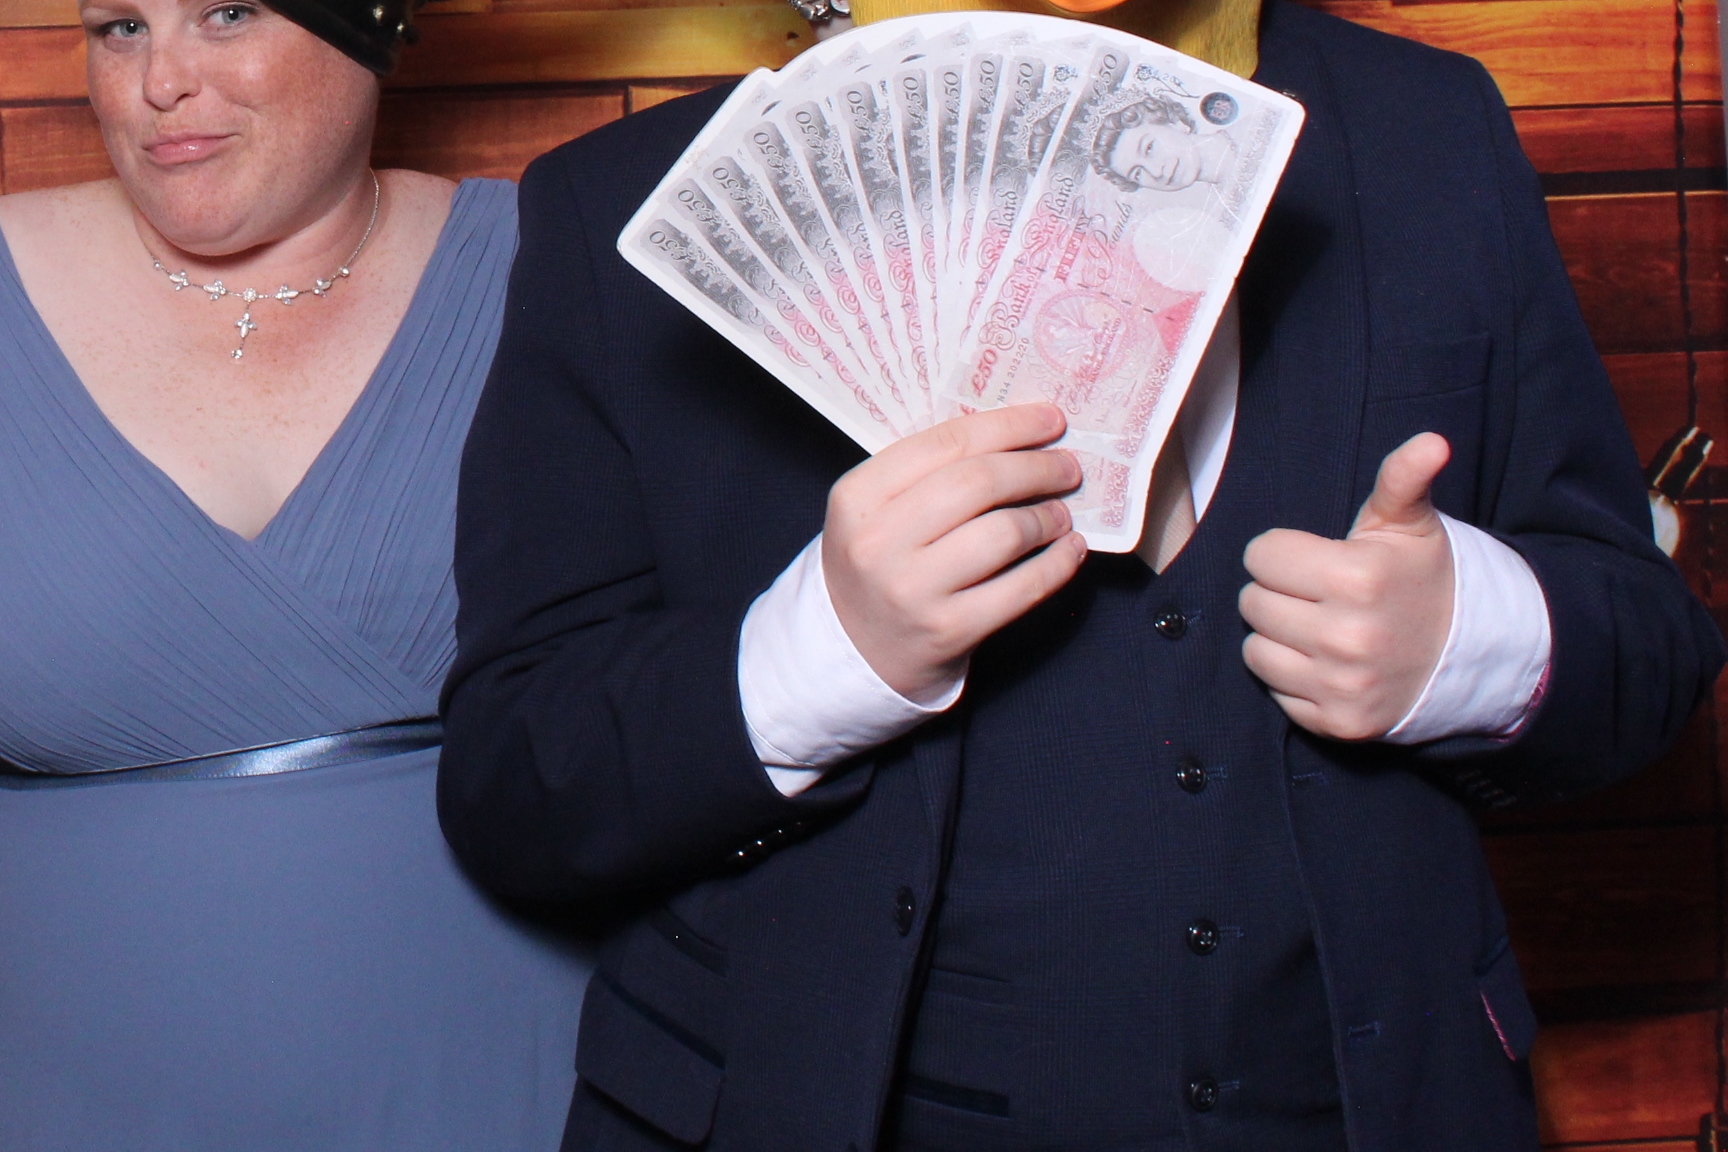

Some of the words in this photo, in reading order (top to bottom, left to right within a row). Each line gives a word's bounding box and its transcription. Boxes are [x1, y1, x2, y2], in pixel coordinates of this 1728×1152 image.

[943, 71, 961, 119] £50
[979, 60, 996, 112] £50
[1015, 62, 1034, 113] £50
[1092, 53, 1118, 99] £50
[847, 90, 873, 134] £50
[903, 76, 923, 125] £50
[753, 132, 789, 174] £50
[795, 110, 826, 152] £50
[677, 189, 719, 226] £50
[712, 167, 753, 204] £50
[649, 230, 693, 262] £50
[1021, 172, 1075, 272] England
[1054, 208, 1093, 284] FIFTY
[1081, 199, 1133, 288] Pounds
[1025, 266, 1038, 284] of
[978, 275, 1031, 351] Bank
[971, 348, 998, 398] £50
[996, 381, 1012, 403] N34
[1006, 337, 1030, 379] 202220
